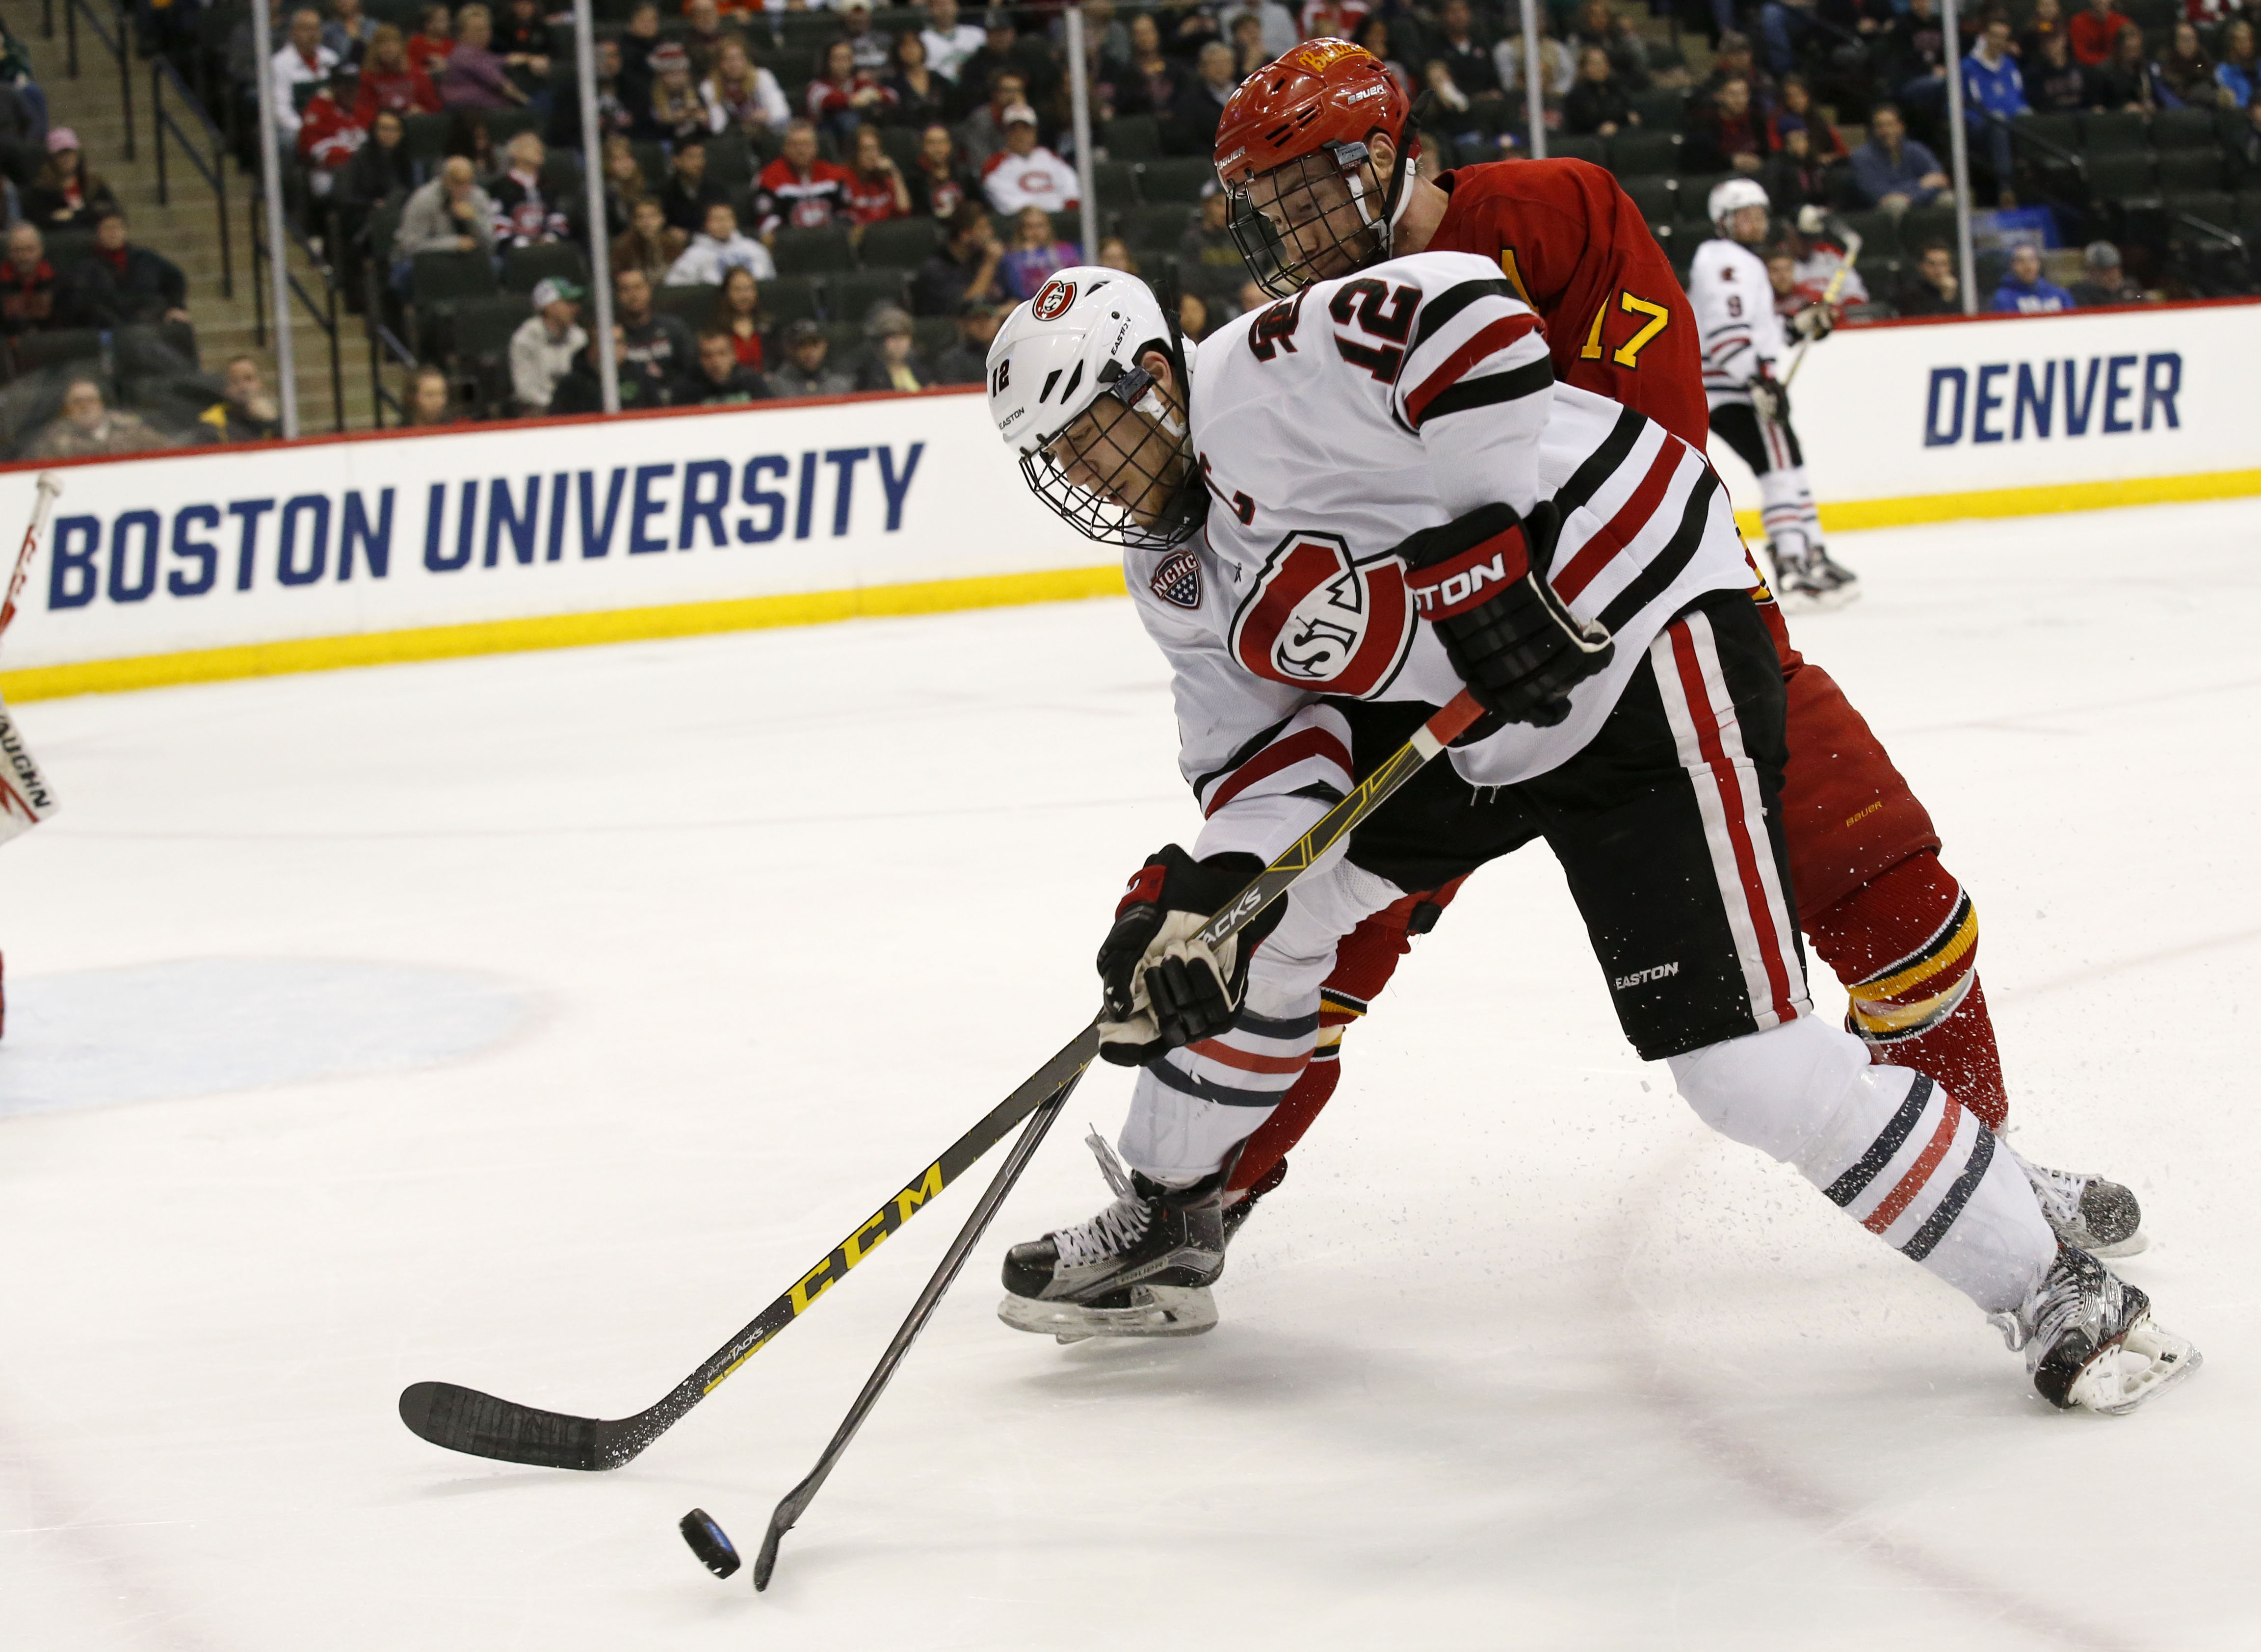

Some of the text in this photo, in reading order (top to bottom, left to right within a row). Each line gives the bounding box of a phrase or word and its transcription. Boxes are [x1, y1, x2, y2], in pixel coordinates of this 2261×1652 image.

[1347, 84, 1387, 105] BAUER
[1329, 278, 1423, 385] 12
[1580, 288, 1669, 370] 17
[993, 359, 1010, 398] 12
[1924, 351, 2182, 447] DENVER
[999, 407, 1025, 430] EASTON
[47, 486, 394, 611] BOSTON
[423, 441, 925, 573] UNIVERSITY
[1153, 554, 1197, 597] NCHC
[1846, 801, 1883, 828] BAUER
[1615, 962, 1679, 991] EASTON
[785, 1161, 944, 1316] CCM
